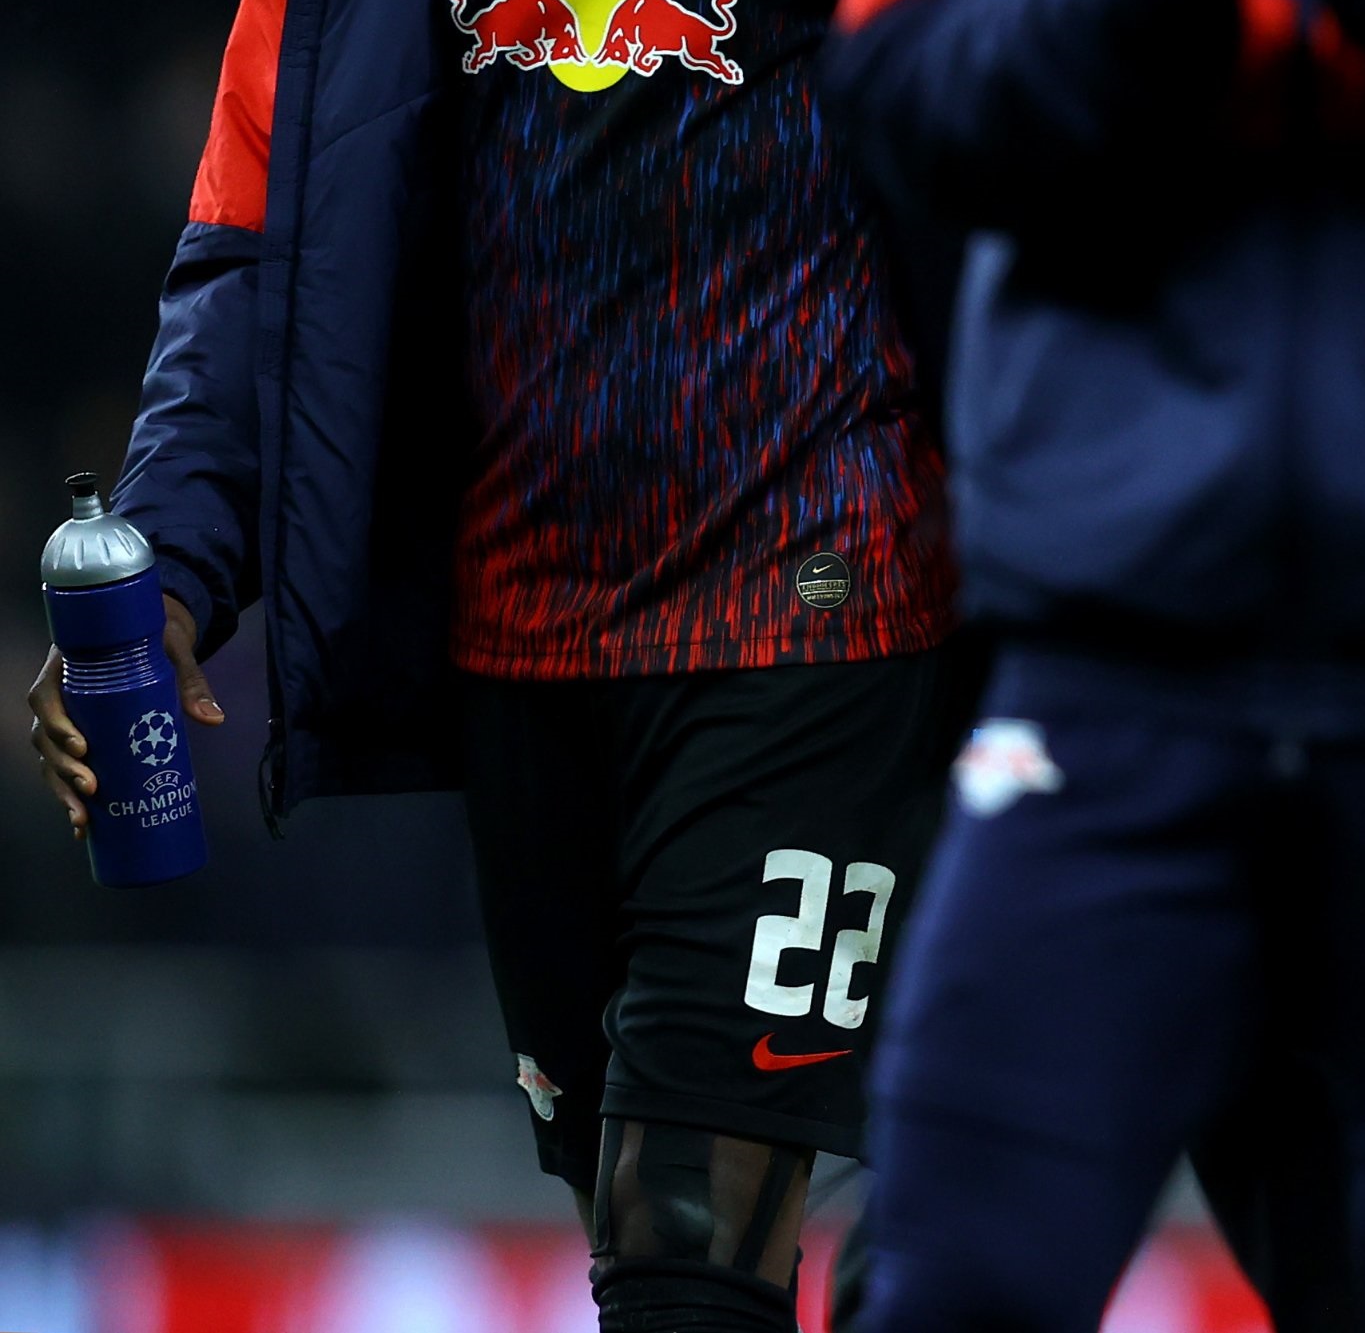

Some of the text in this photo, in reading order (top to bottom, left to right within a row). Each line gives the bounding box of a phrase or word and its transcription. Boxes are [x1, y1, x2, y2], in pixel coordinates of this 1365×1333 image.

[145, 773, 179, 792] UEFA
[141, 801, 193, 828] LEAGUE
[744, 849, 896, 1029] 22
